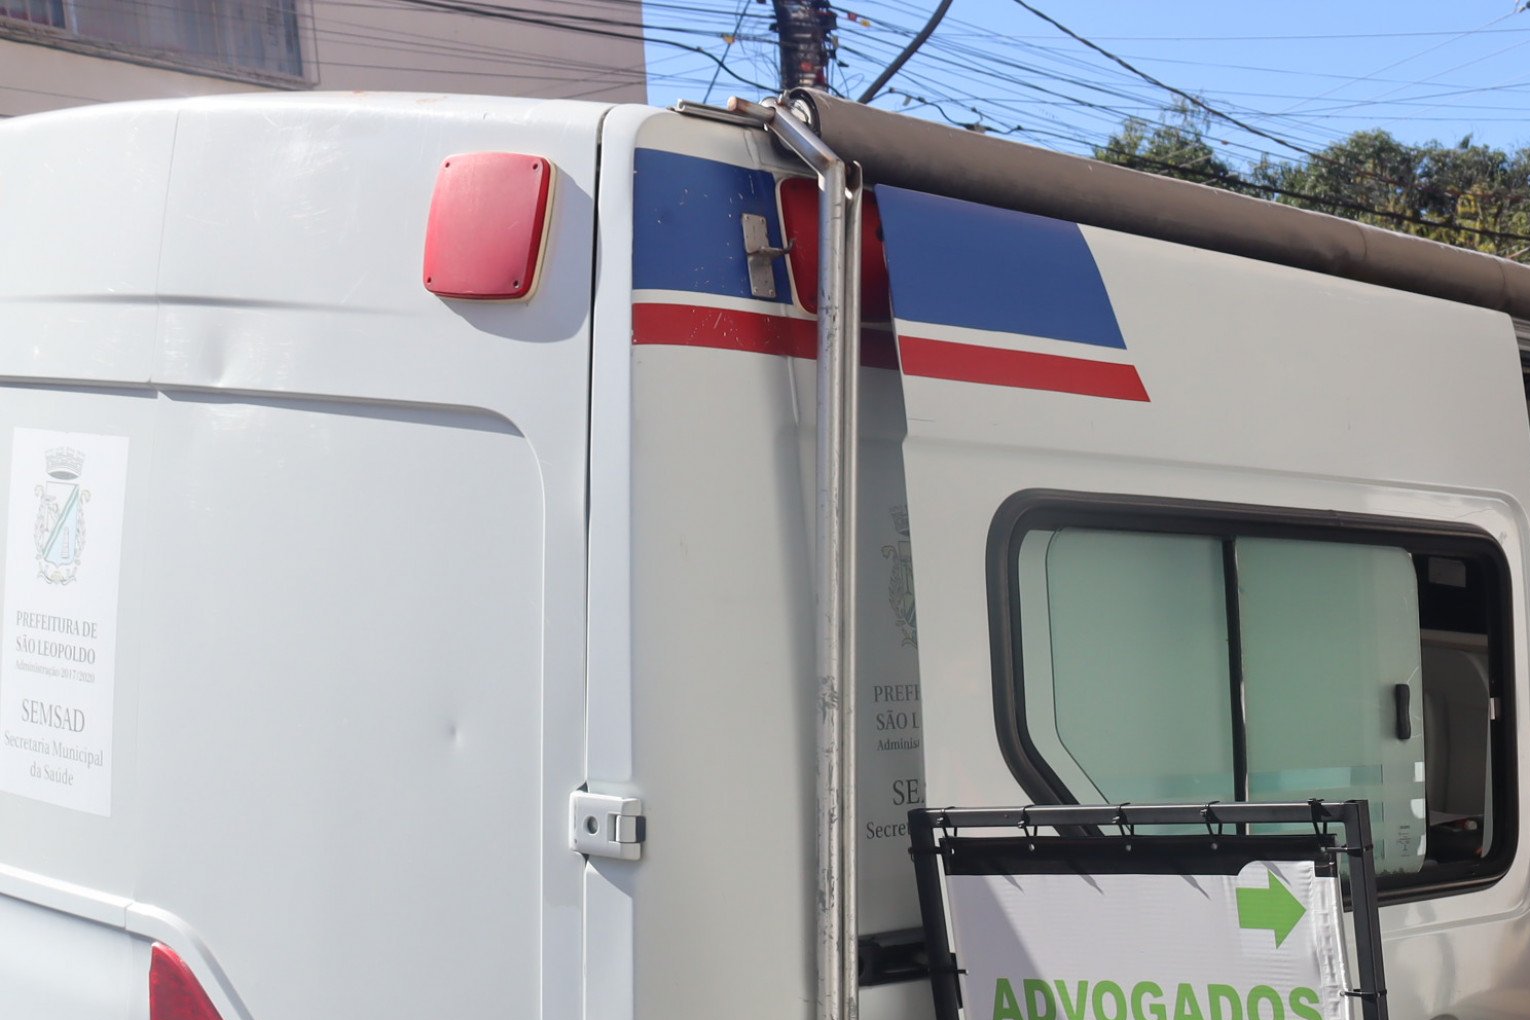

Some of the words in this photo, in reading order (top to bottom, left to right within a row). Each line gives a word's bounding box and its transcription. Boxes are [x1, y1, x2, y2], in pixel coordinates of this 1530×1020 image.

[16, 610, 80, 637] PREFEITURA
[82, 621, 98, 640] DE
[16, 634, 36, 655] SÃO
[37, 639, 96, 665] LEOPOLDO
[21, 698, 86, 733] SEMSAD
[876, 710, 907, 731] SÃO
[4, 730, 50, 756] Secretaria
[52, 739, 104, 769] Municipal
[876, 738, 920, 751] Adminis
[30, 760, 42, 779] da
[44, 763, 74, 787] Saúde
[892, 778, 925, 806] SE
